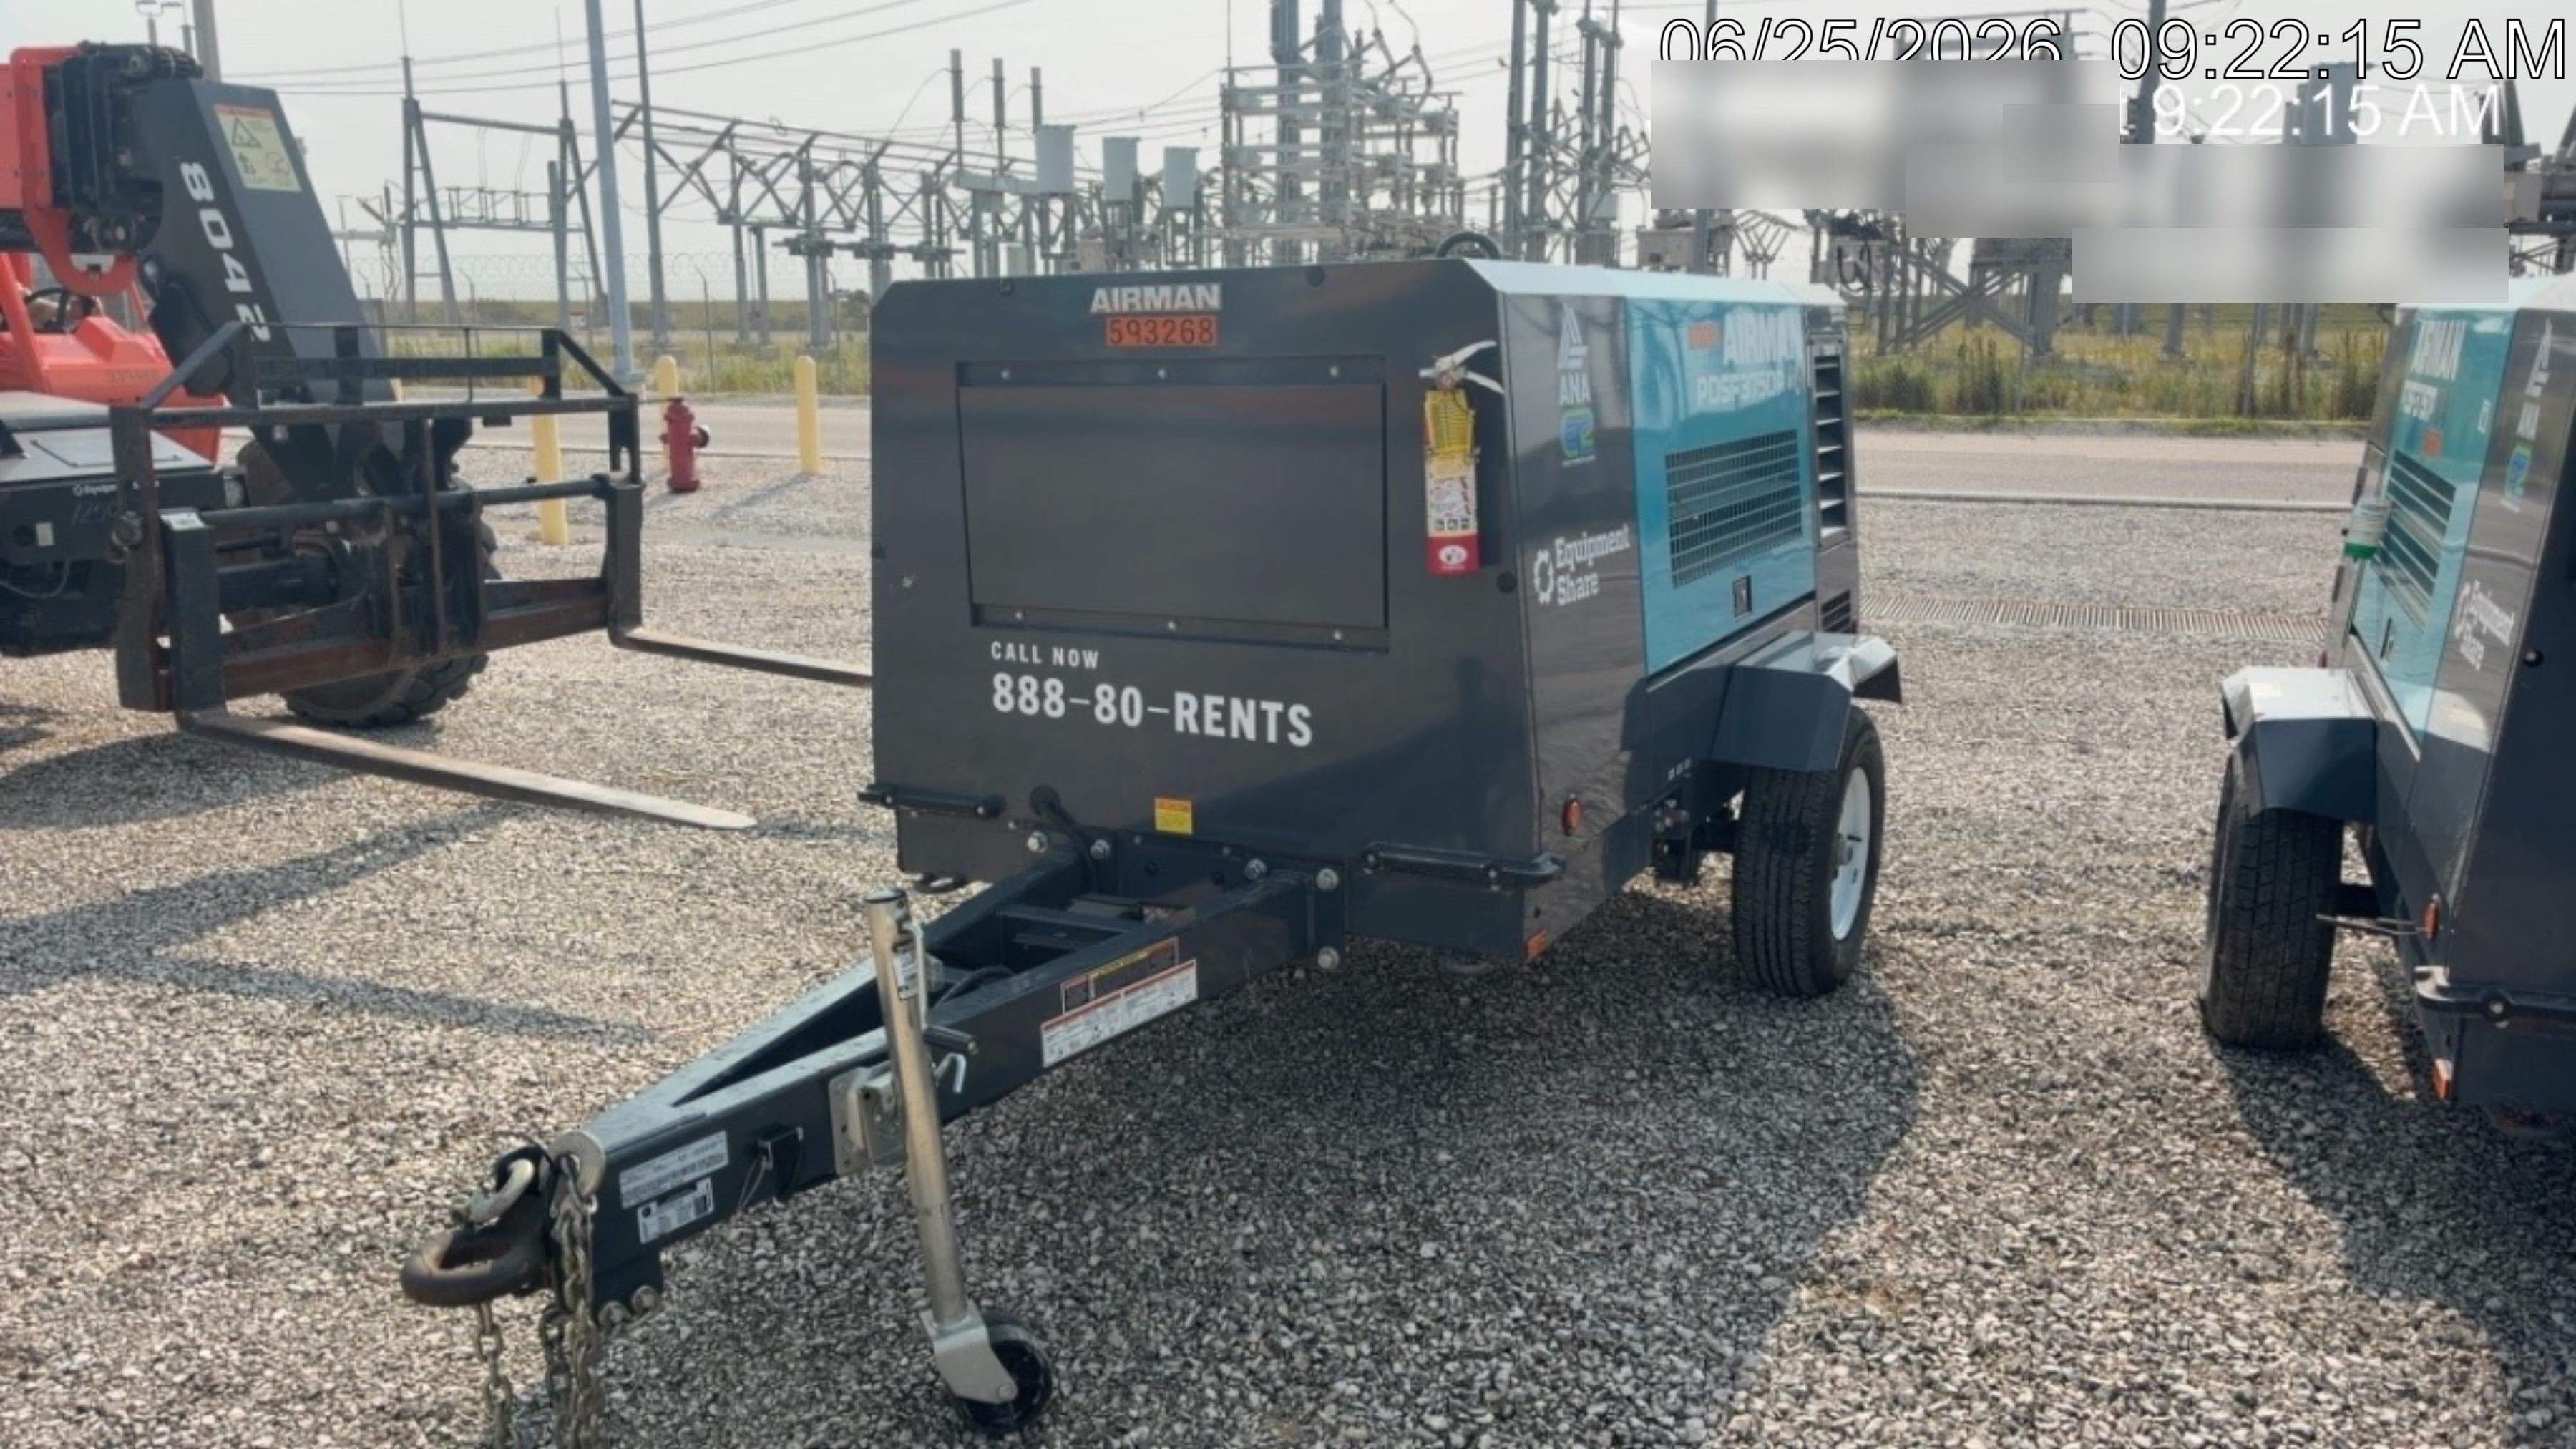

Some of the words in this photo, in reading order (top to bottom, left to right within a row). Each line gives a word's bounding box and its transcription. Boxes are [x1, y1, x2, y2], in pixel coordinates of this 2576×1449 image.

[180, 161, 271, 342] 8042
[1089, 283, 1222, 313] AIRMAN
[1109, 318, 1214, 344] 593268
[1723, 309, 1803, 366] AIRMAN
[1559, 371, 1591, 406] ANA
[1554, 523, 1631, 572] Equipment
[1556, 573, 1599, 606] Share
[991, 641, 1043, 665] CALL
[1053, 647, 1099, 669] NOW
[992, 672, 1313, 747] 888-80-RENTS
